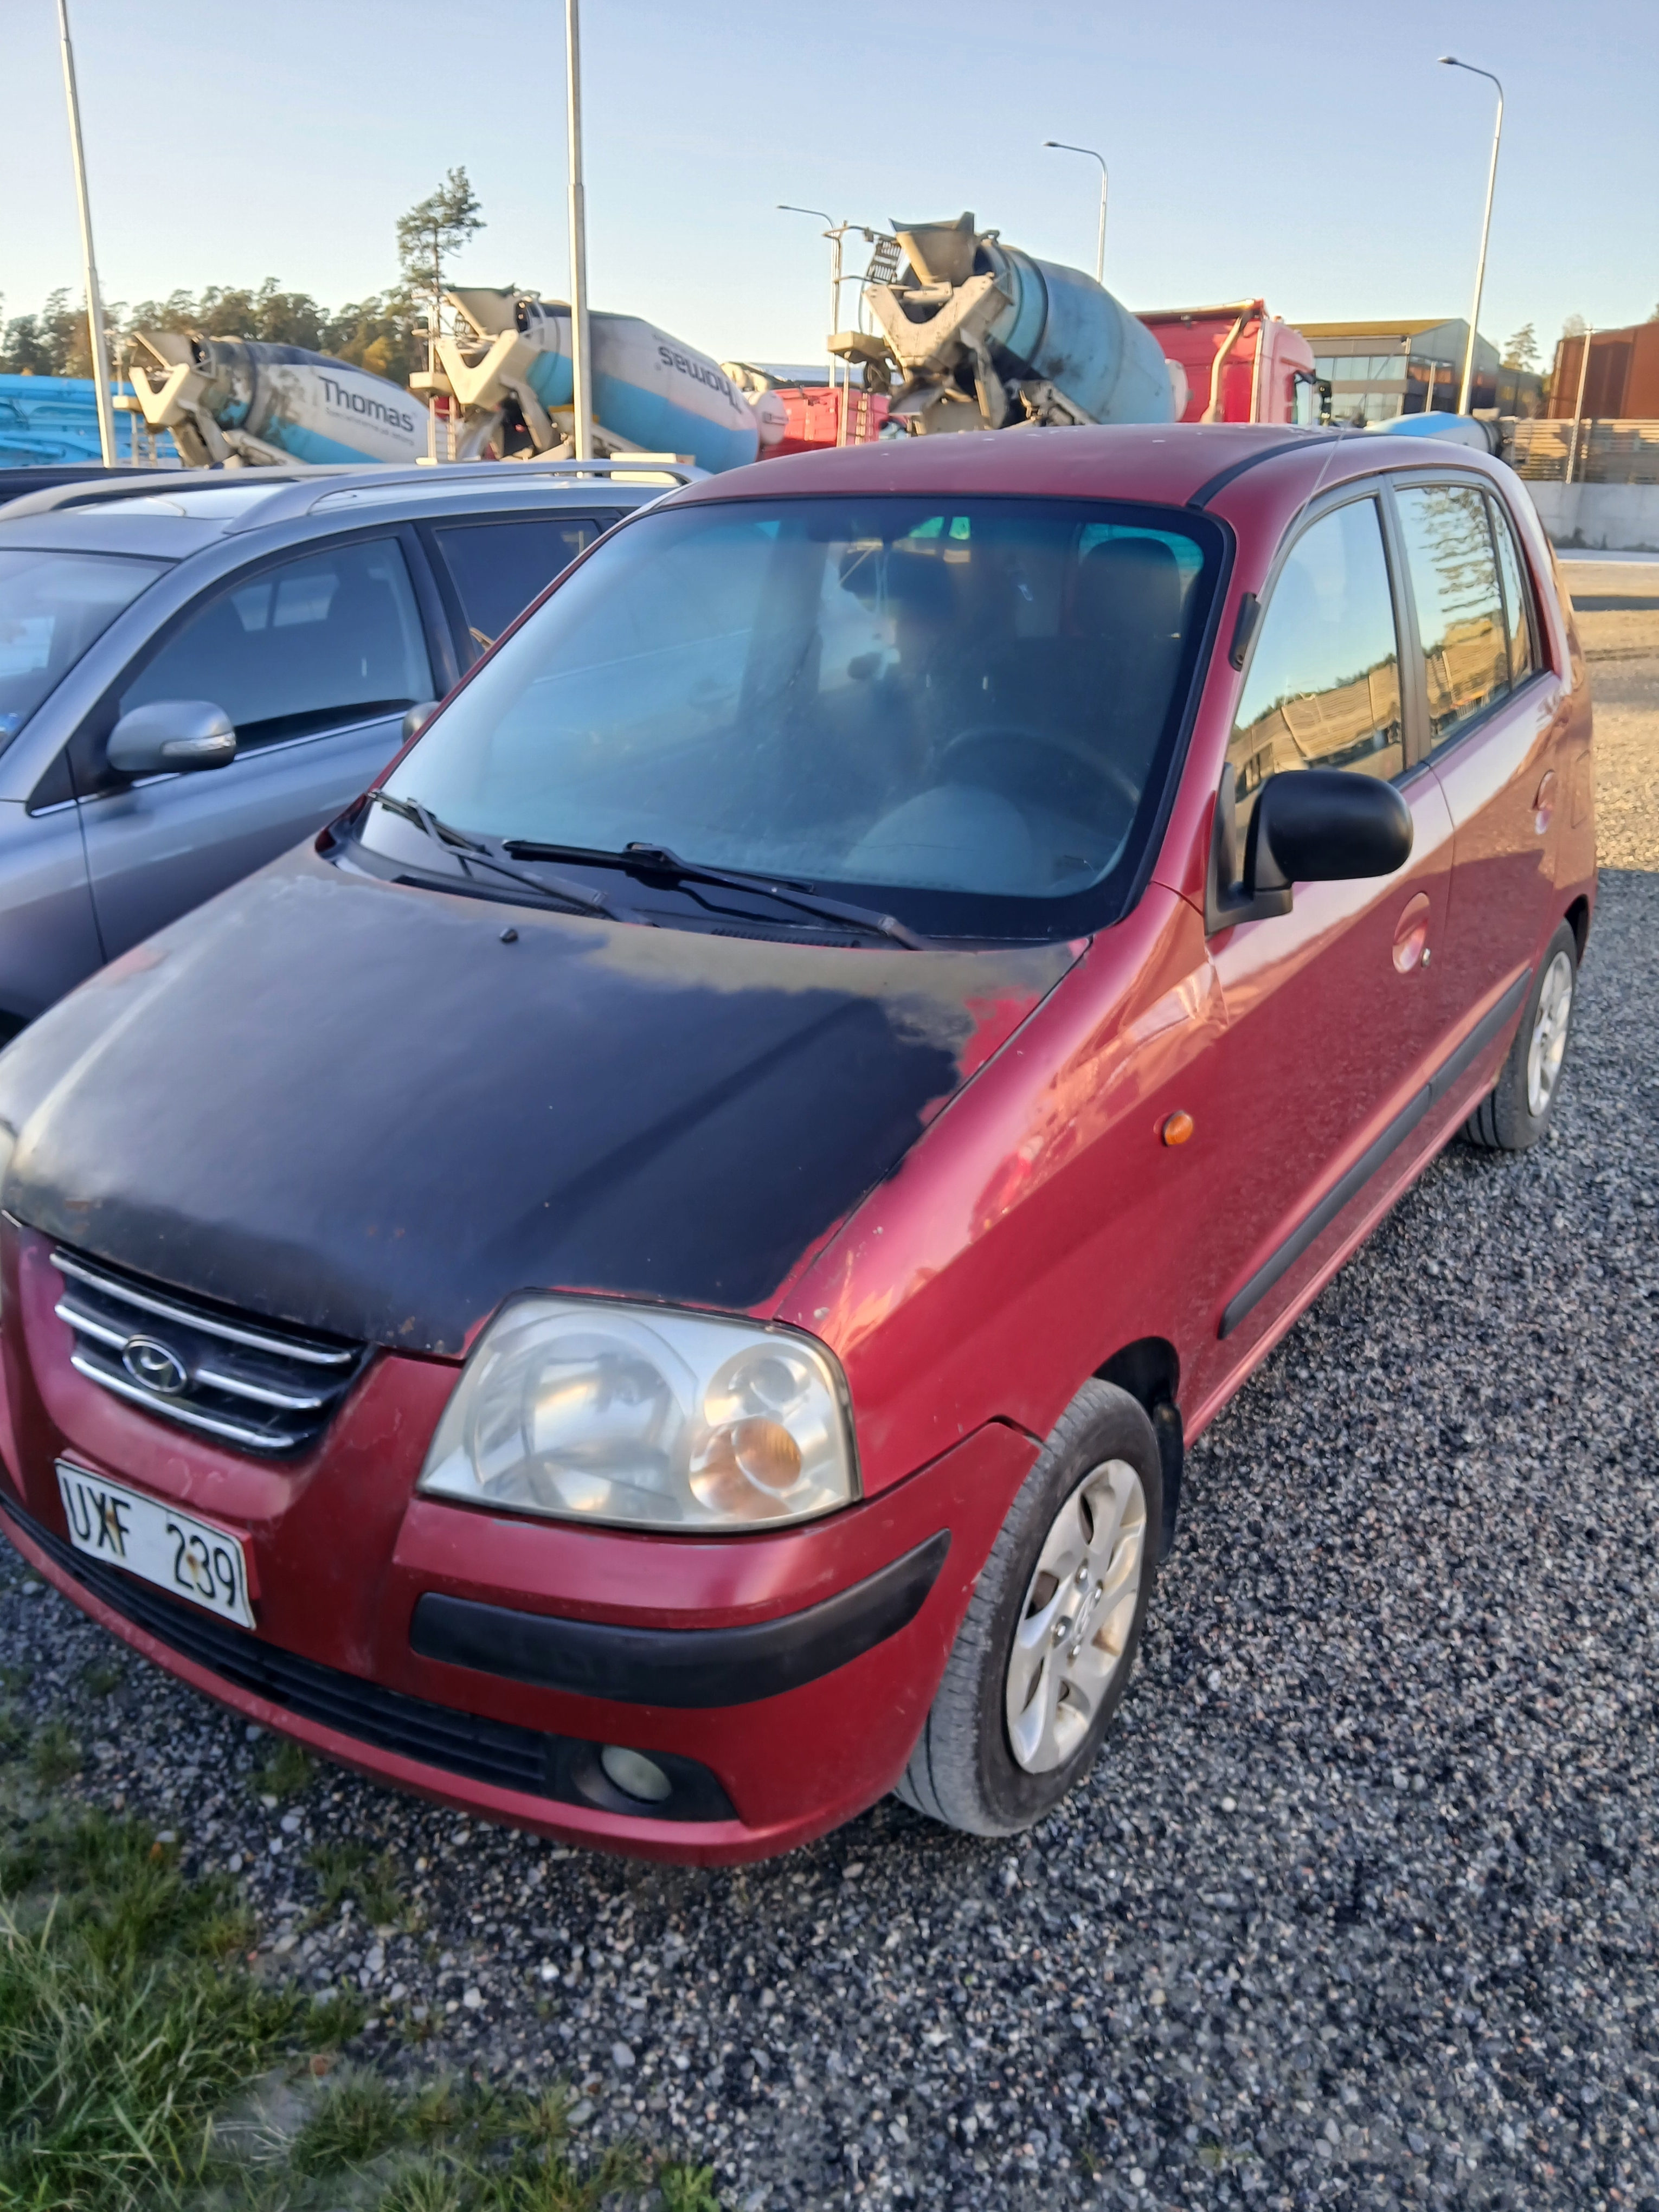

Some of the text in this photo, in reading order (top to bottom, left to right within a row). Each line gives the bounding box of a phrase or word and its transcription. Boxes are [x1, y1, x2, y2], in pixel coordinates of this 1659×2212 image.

[318, 375, 414, 432] Thomas
[658, 345, 743, 415] Thomas
[63, 1477, 236, 1607] UXF 239
